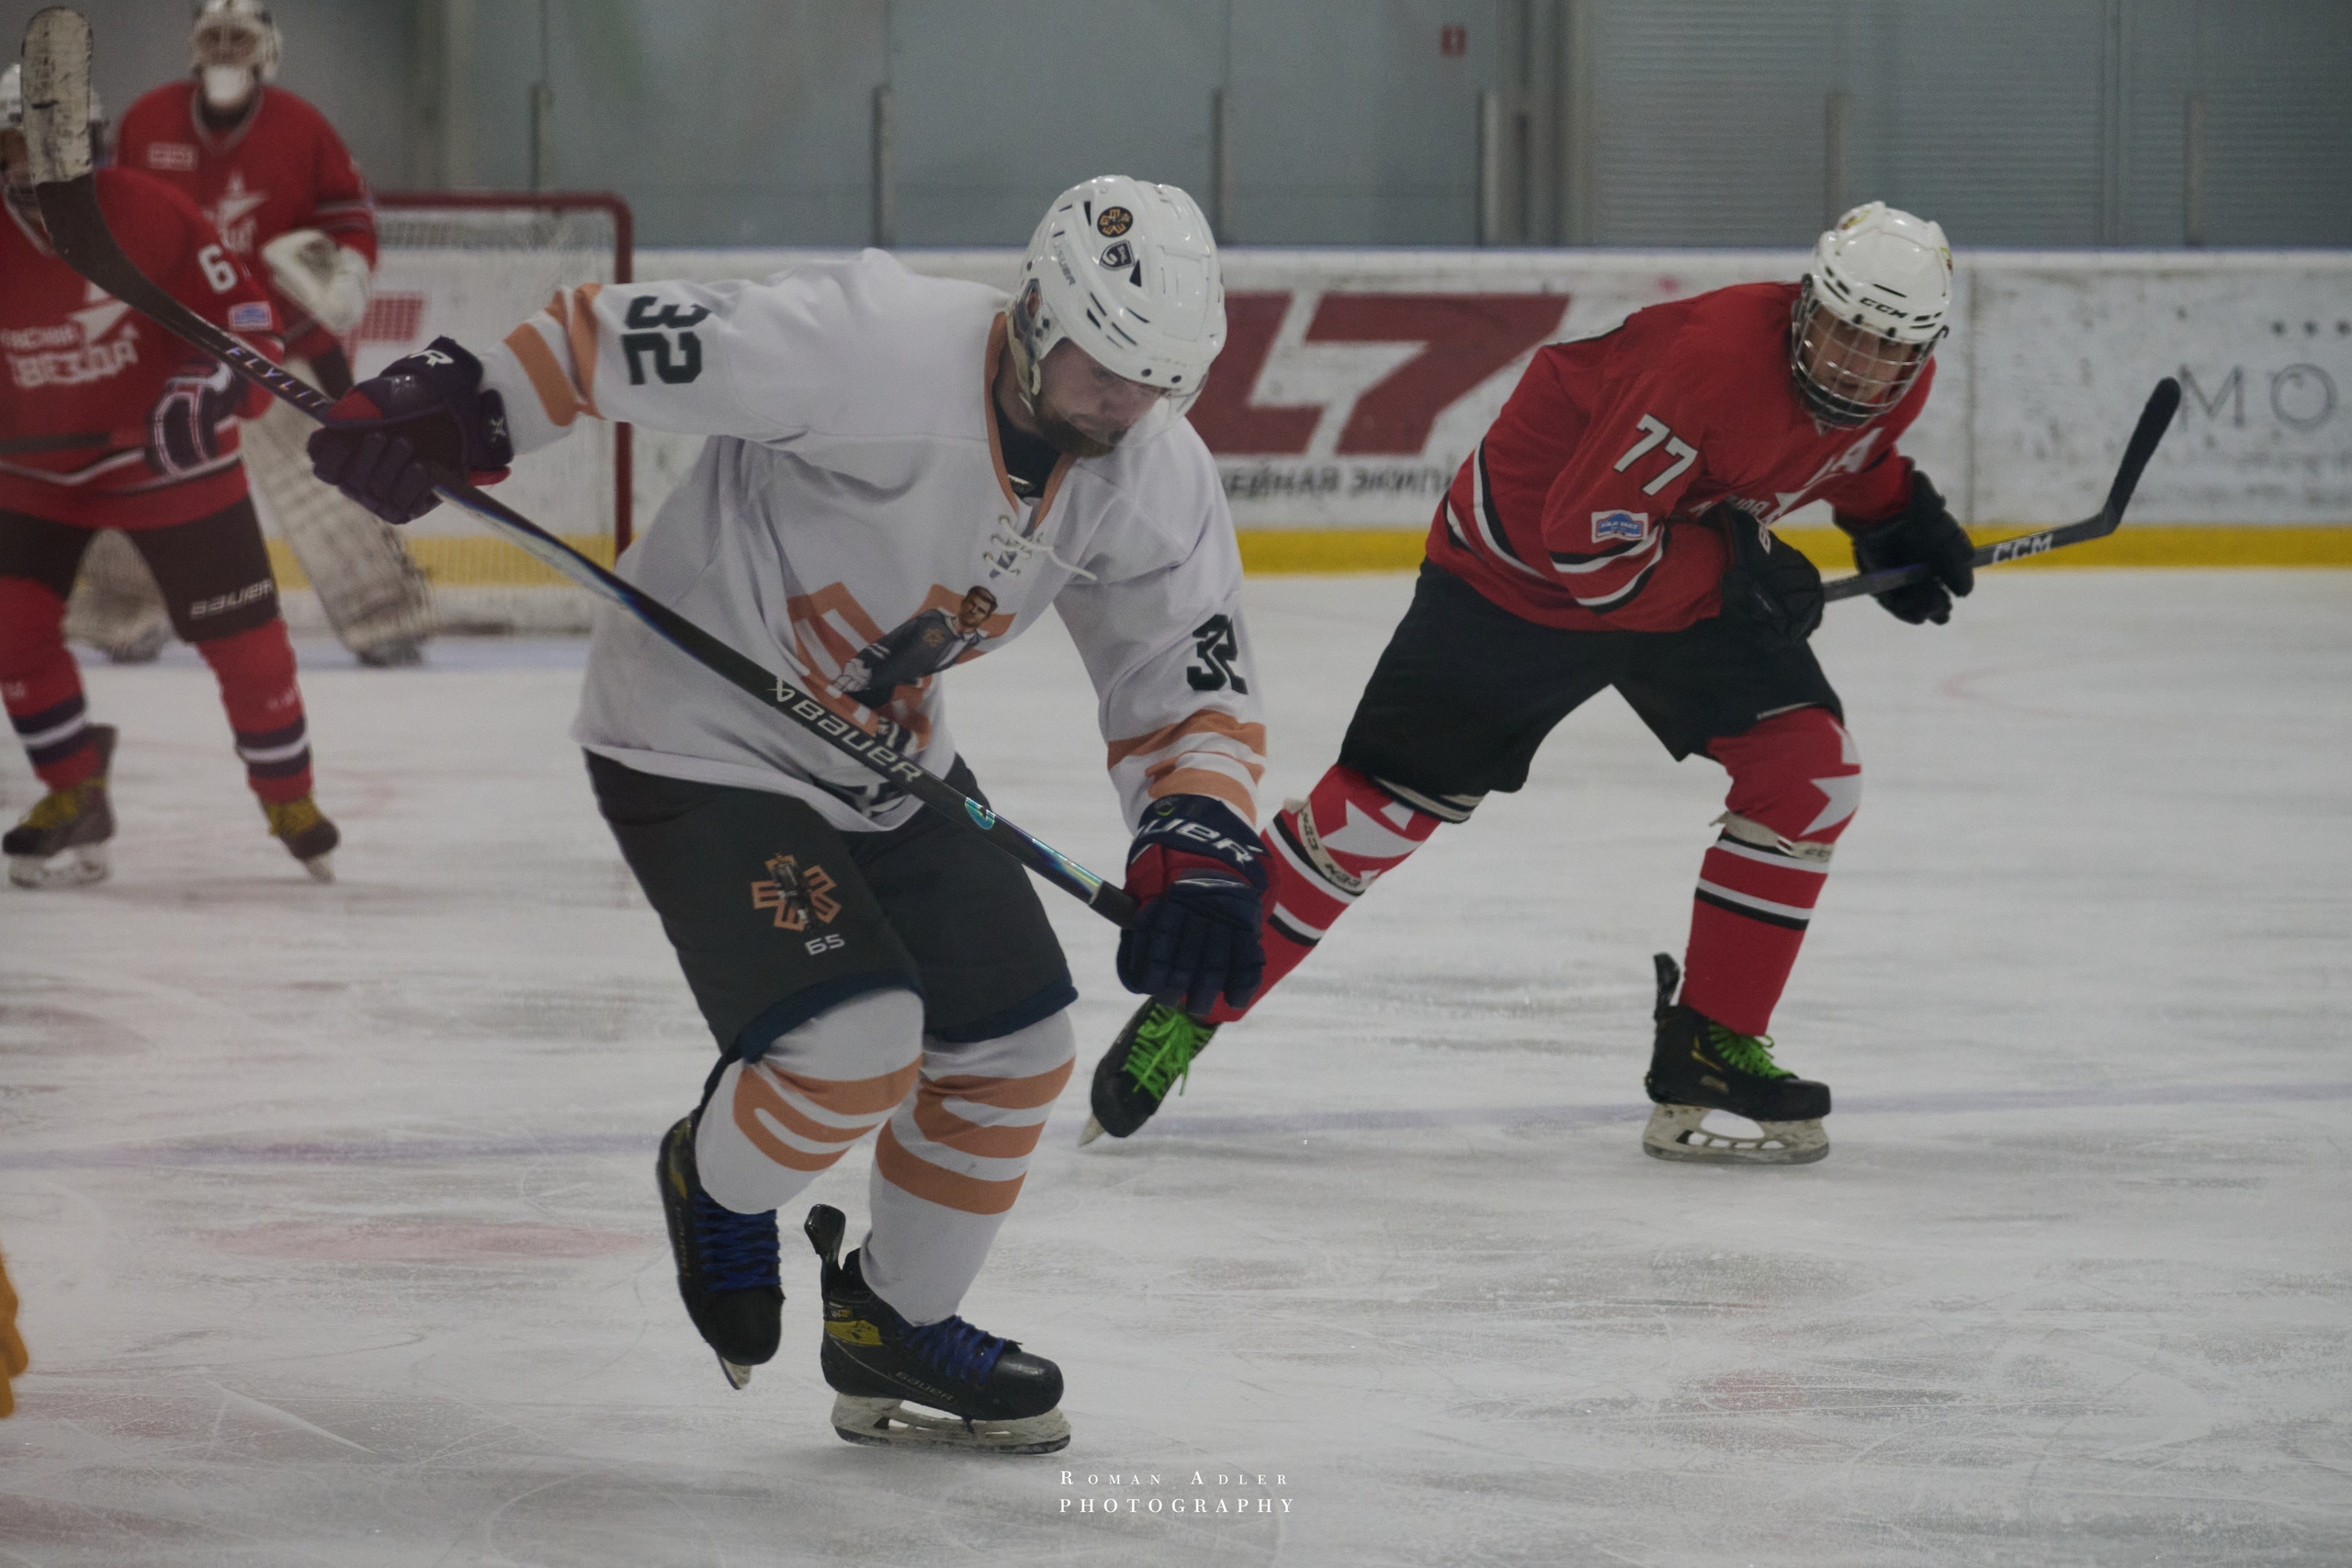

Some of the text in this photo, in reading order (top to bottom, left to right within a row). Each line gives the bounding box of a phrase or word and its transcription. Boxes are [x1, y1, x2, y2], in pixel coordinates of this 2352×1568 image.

[1859, 297, 1907, 319] CCM
[621, 295, 712, 385] 32
[1612, 413, 1699, 497] 77
[1991, 532, 2054, 565] CCM
[791, 698, 922, 783] BAUER
[805, 933, 845, 956] 65
